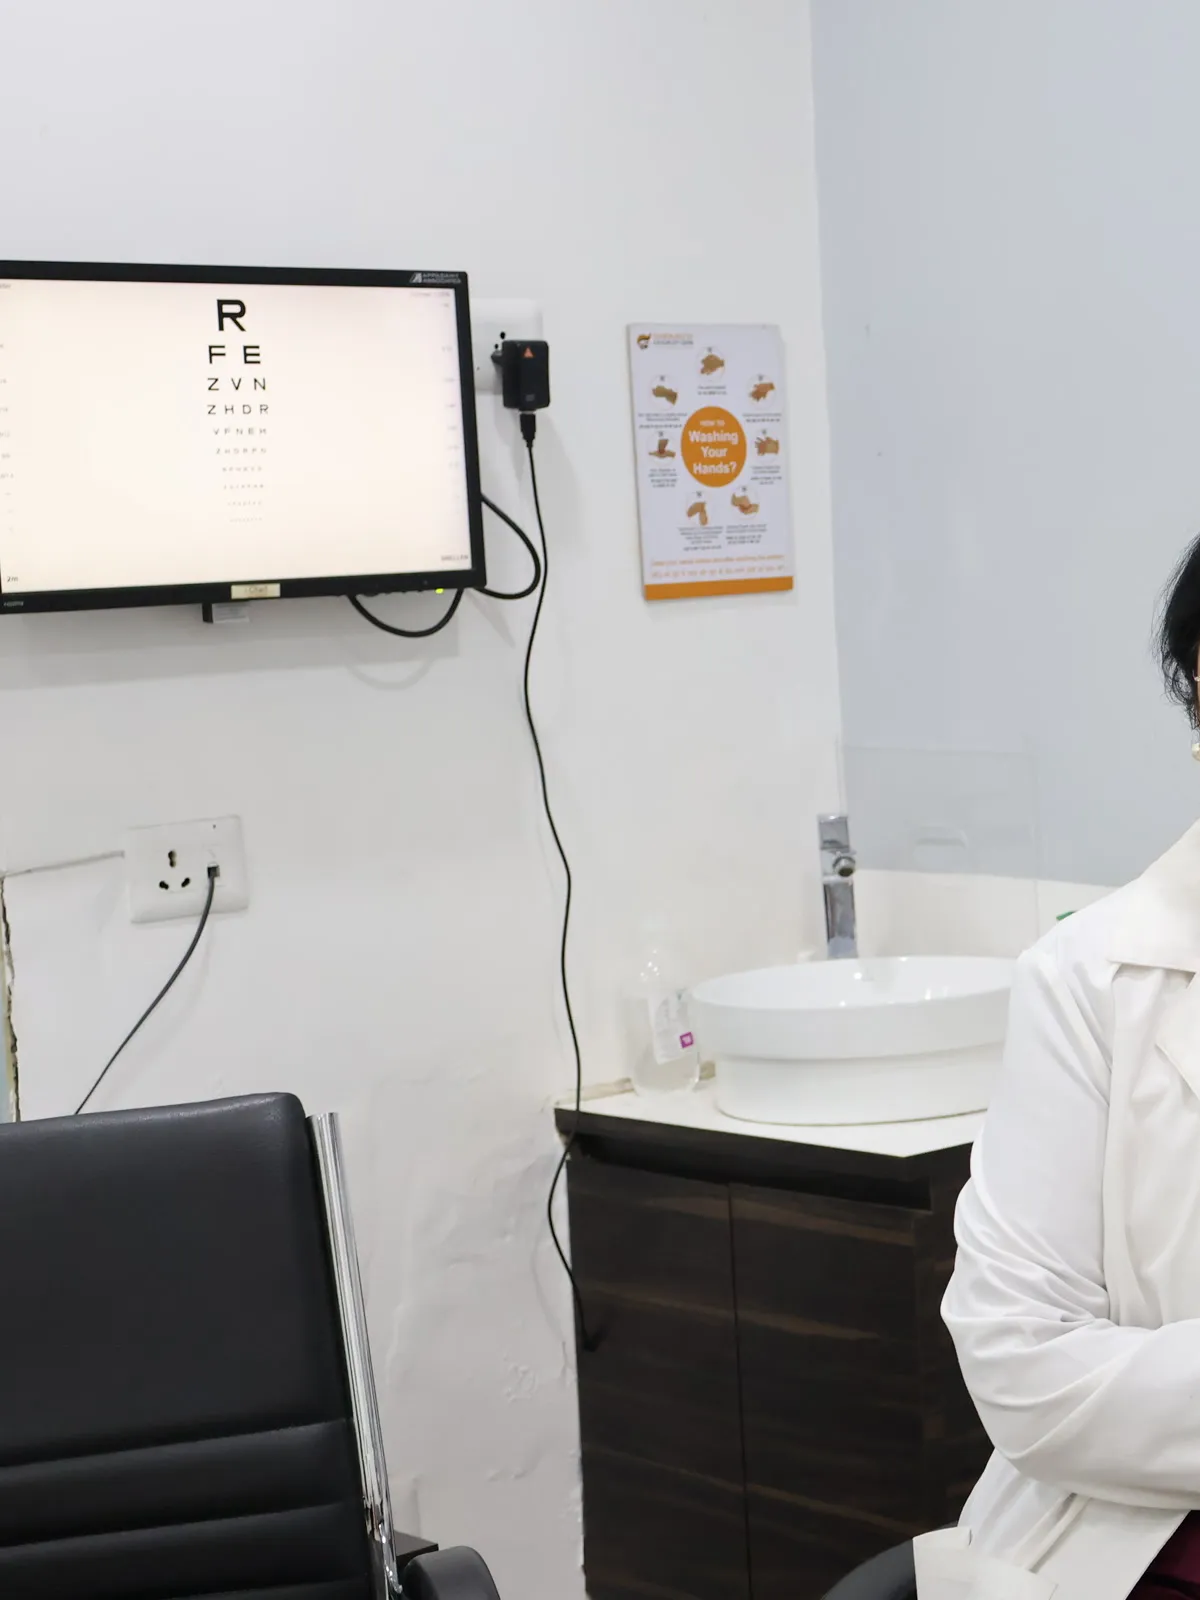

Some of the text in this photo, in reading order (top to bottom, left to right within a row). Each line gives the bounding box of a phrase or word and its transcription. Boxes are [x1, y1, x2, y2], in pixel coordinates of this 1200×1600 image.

[216, 299, 247, 332] R
[688, 430, 739, 446] Washing
[701, 446, 728, 459] Your
[692, 461, 738, 475] Hands?
